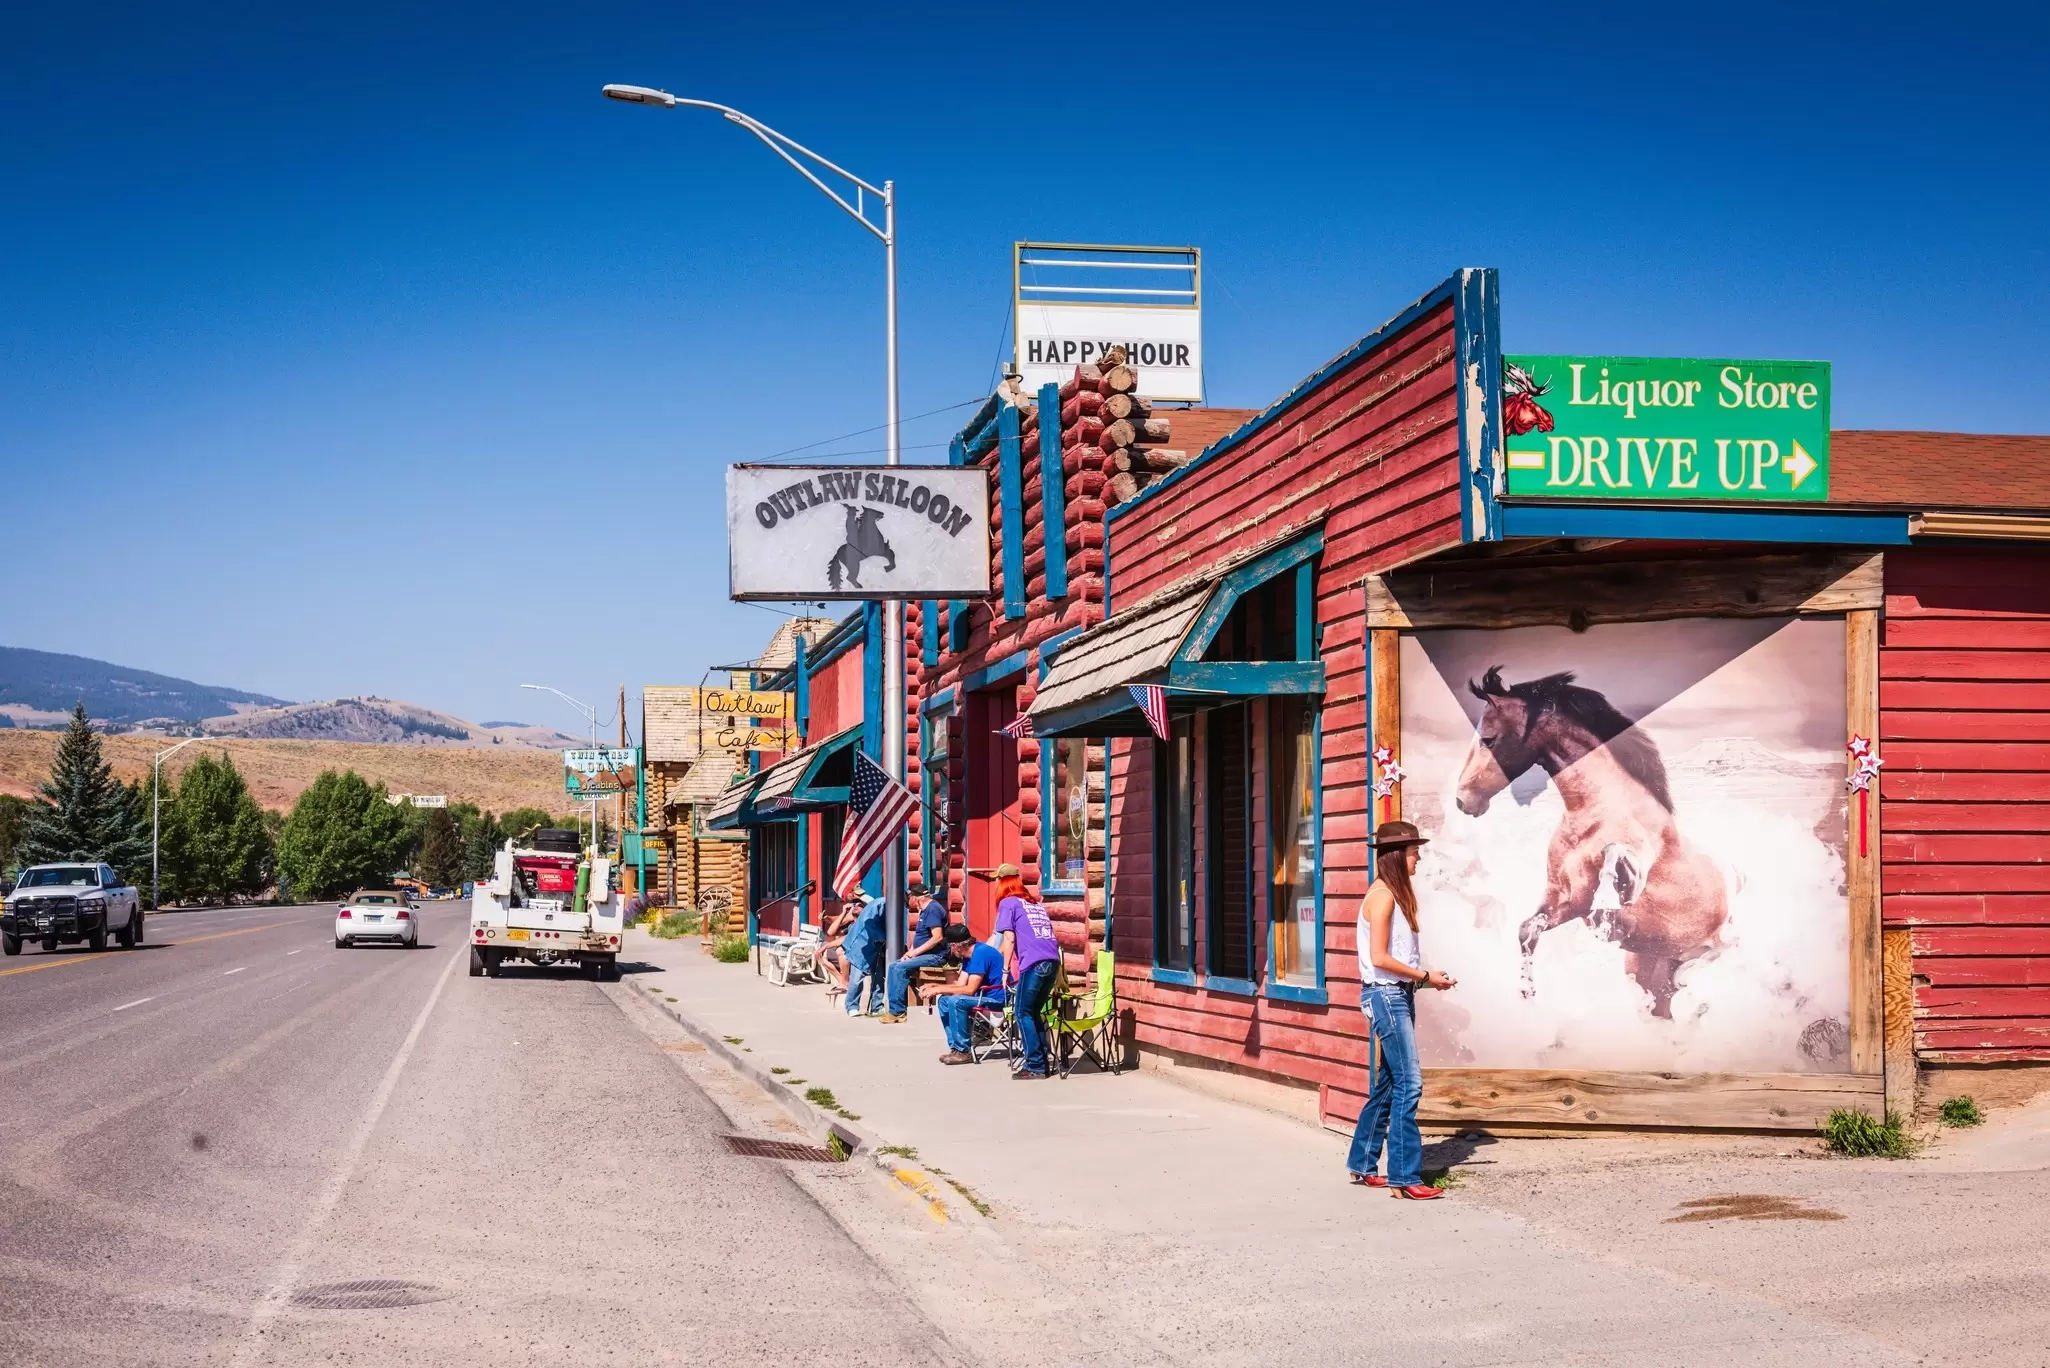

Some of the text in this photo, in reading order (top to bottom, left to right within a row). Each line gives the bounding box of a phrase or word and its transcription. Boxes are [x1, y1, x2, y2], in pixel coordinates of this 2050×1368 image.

[1028, 340, 1190, 366] HAPPY HOUR
[1568, 364, 1818, 419] Liquor Store
[1546, 435, 1779, 490] DRIVE UP
[755, 471, 973, 538] OUTLAW SALOON
[706, 692, 781, 714] Outlaw
[715, 728, 760, 749] Café
[571, 751, 595, 760] TWIN
[578, 762, 624, 773] LODGE
[590, 780, 620, 790] cabins
